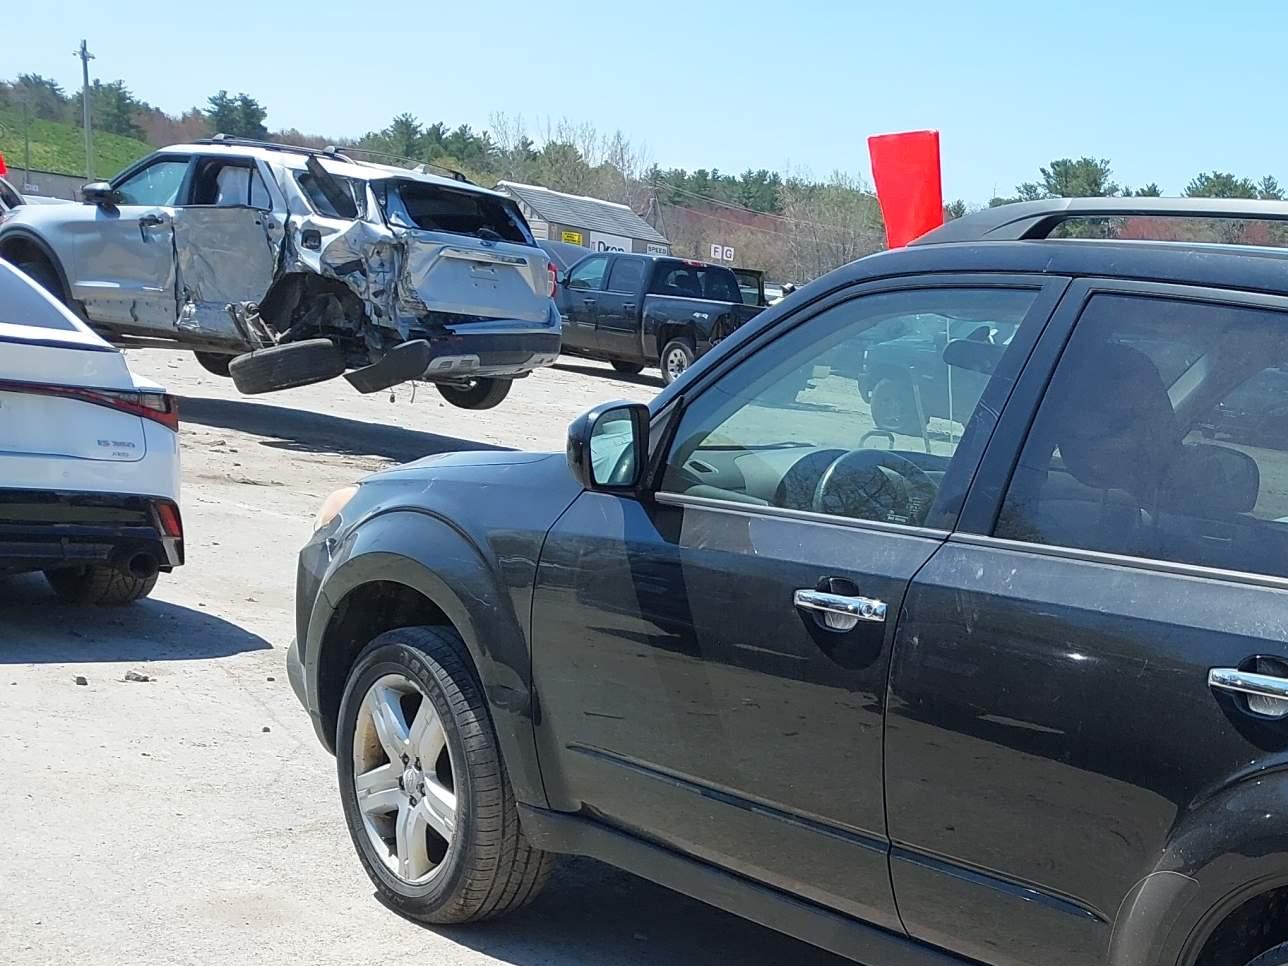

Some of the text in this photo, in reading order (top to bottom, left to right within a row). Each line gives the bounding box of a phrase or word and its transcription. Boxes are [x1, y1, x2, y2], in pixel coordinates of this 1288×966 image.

[647, 245, 667, 255] SPEED
[713, 246, 732, 259] F G
